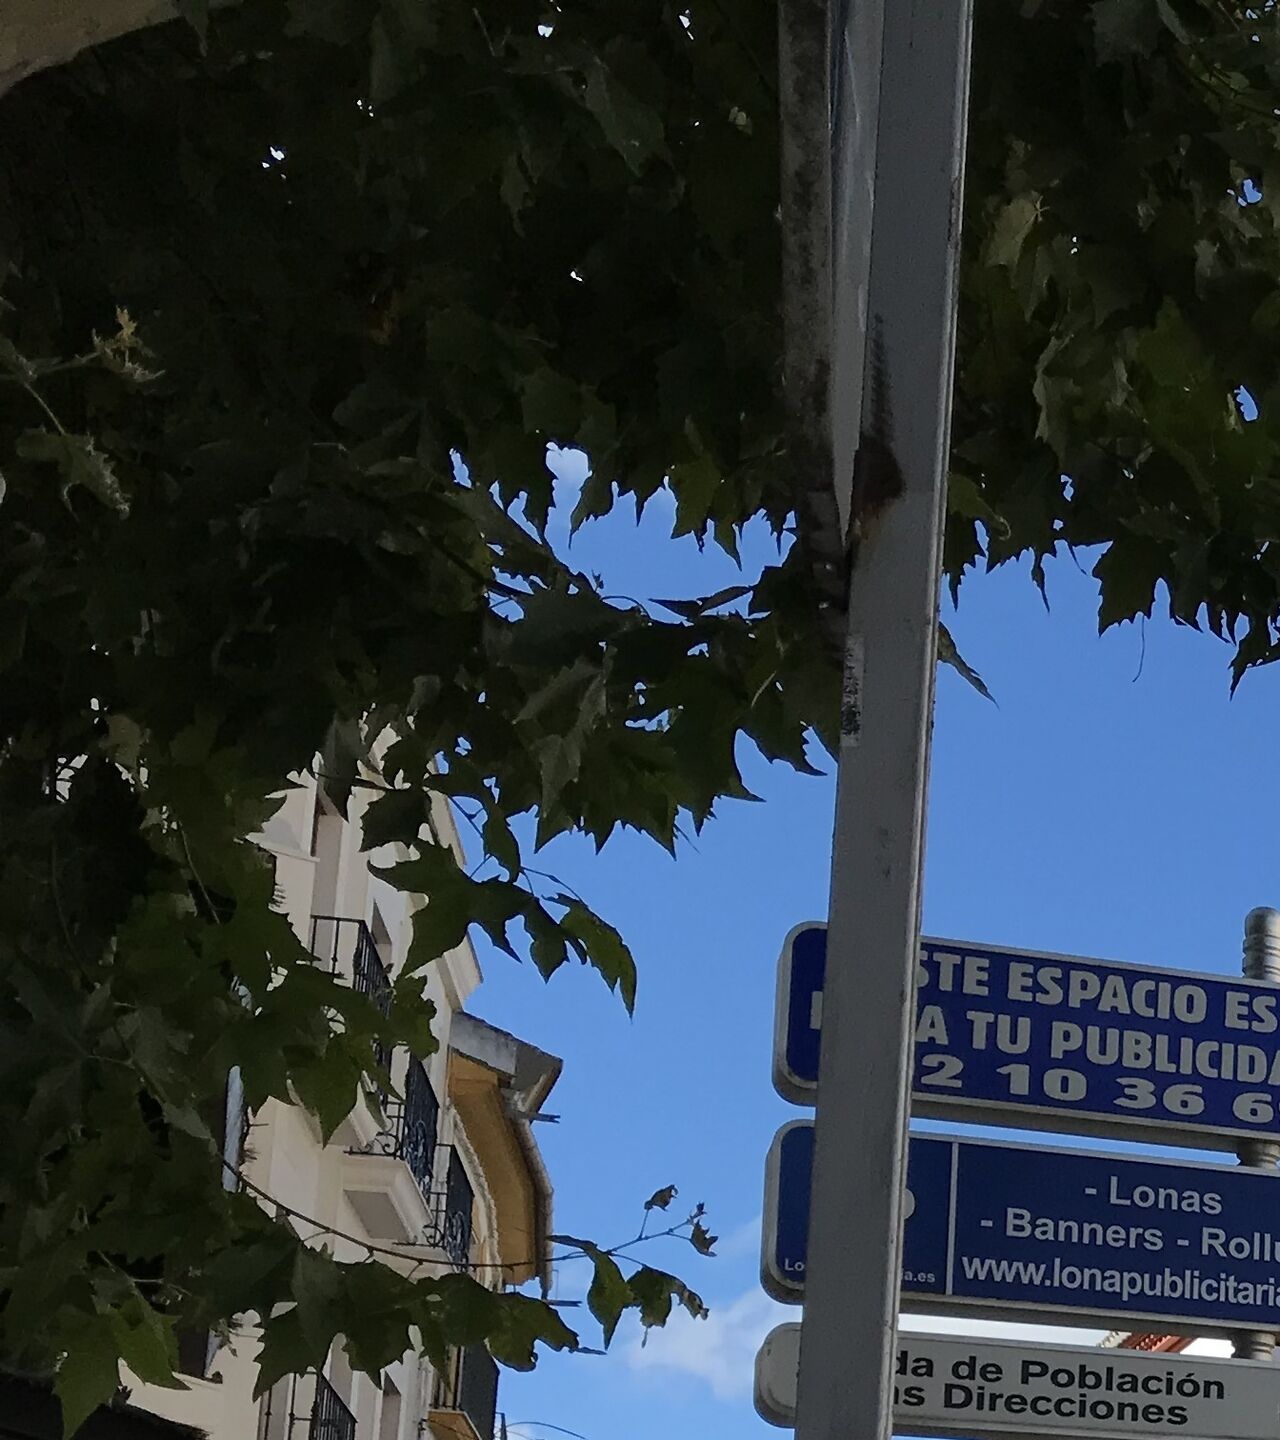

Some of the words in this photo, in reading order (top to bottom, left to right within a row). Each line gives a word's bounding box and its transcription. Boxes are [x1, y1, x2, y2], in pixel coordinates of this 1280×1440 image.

[1008, 961, 1207, 1023] ESPACIO
[1225, 991, 1278, 1033] ES
[966, 1010, 1031, 1054] TU
[996, 1063, 1087, 1101] 10
[1113, 1077, 1205, 1115] 36
[1110, 1176, 1222, 1215] Lonas
[1006, 1208, 1164, 1251] Banners
[951, 1355, 1003, 1384] de
[1020, 1359, 1225, 1400] Población
[943, 1383, 1189, 1426] Direcciones
